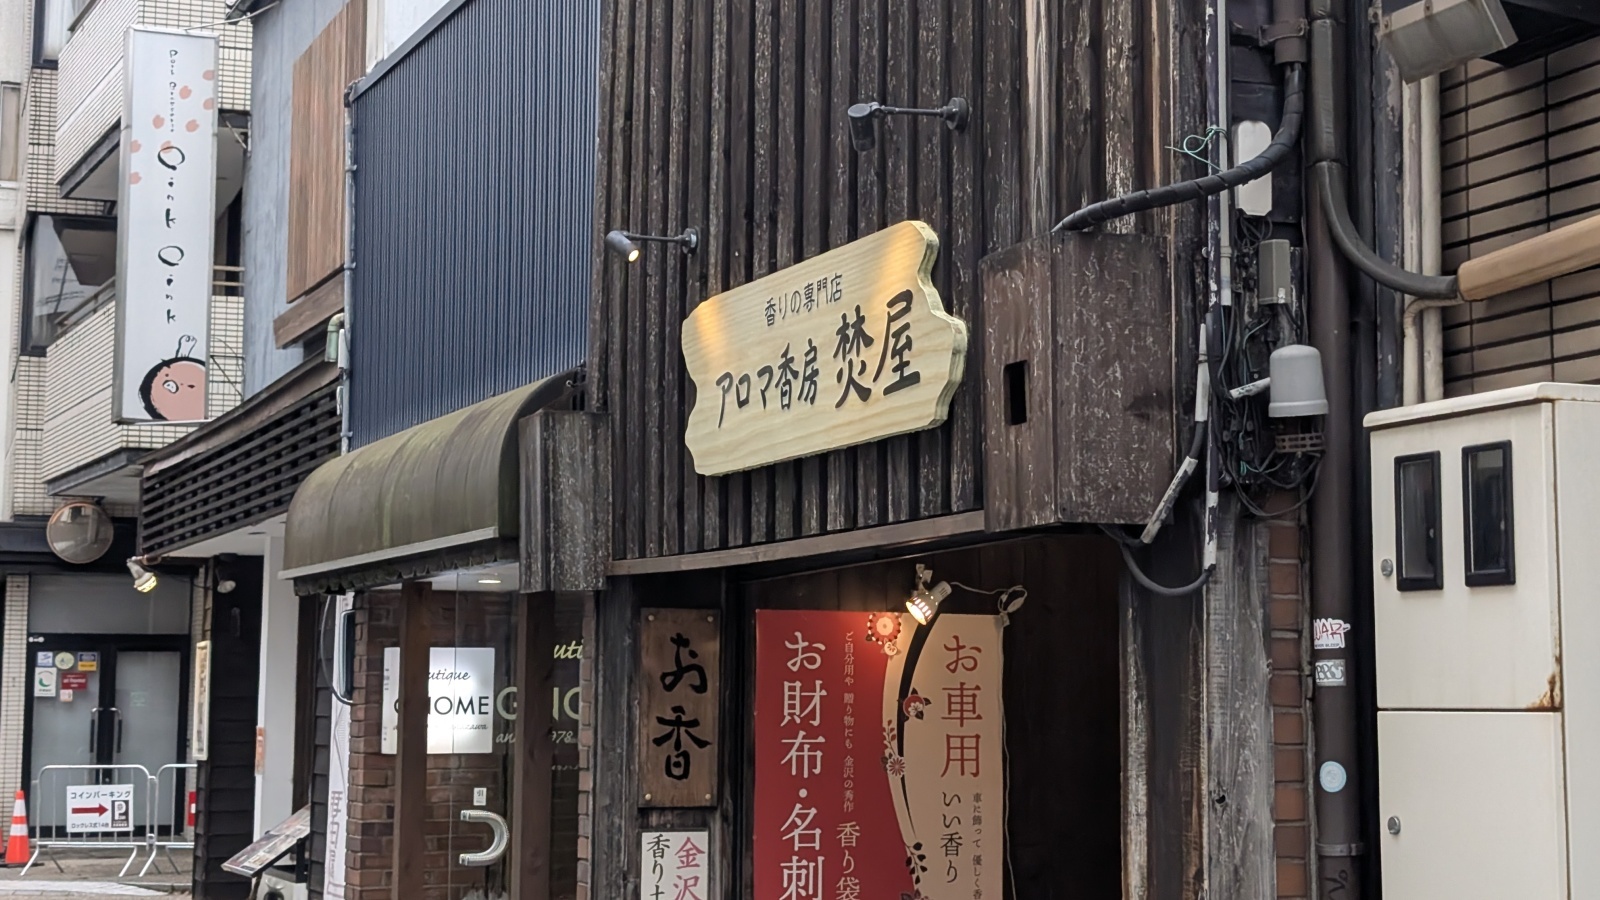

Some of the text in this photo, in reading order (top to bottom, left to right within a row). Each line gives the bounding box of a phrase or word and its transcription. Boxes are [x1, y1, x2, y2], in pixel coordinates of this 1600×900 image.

[157, 146, 185, 325] Oink Oink
[764, 273, 843, 327] 香りの専門店
[715, 288, 921, 429] アロマ香房 焚屋
[394, 696, 489, 715] OME
[429, 668, 471, 686] utique
[652, 632, 713, 781] お香
[70, 790, 131, 799] コインパーキング
[779, 631, 828, 900] お財布・名刺
[836, 631, 861, 900] ご自分用や 贈り物にも 金沢の秀作 香り袋
[940, 635, 983, 884] お車用 いい香り
[673, 836, 706, 900] 金沢
[972, 792, 983, 848] 車に飾って
